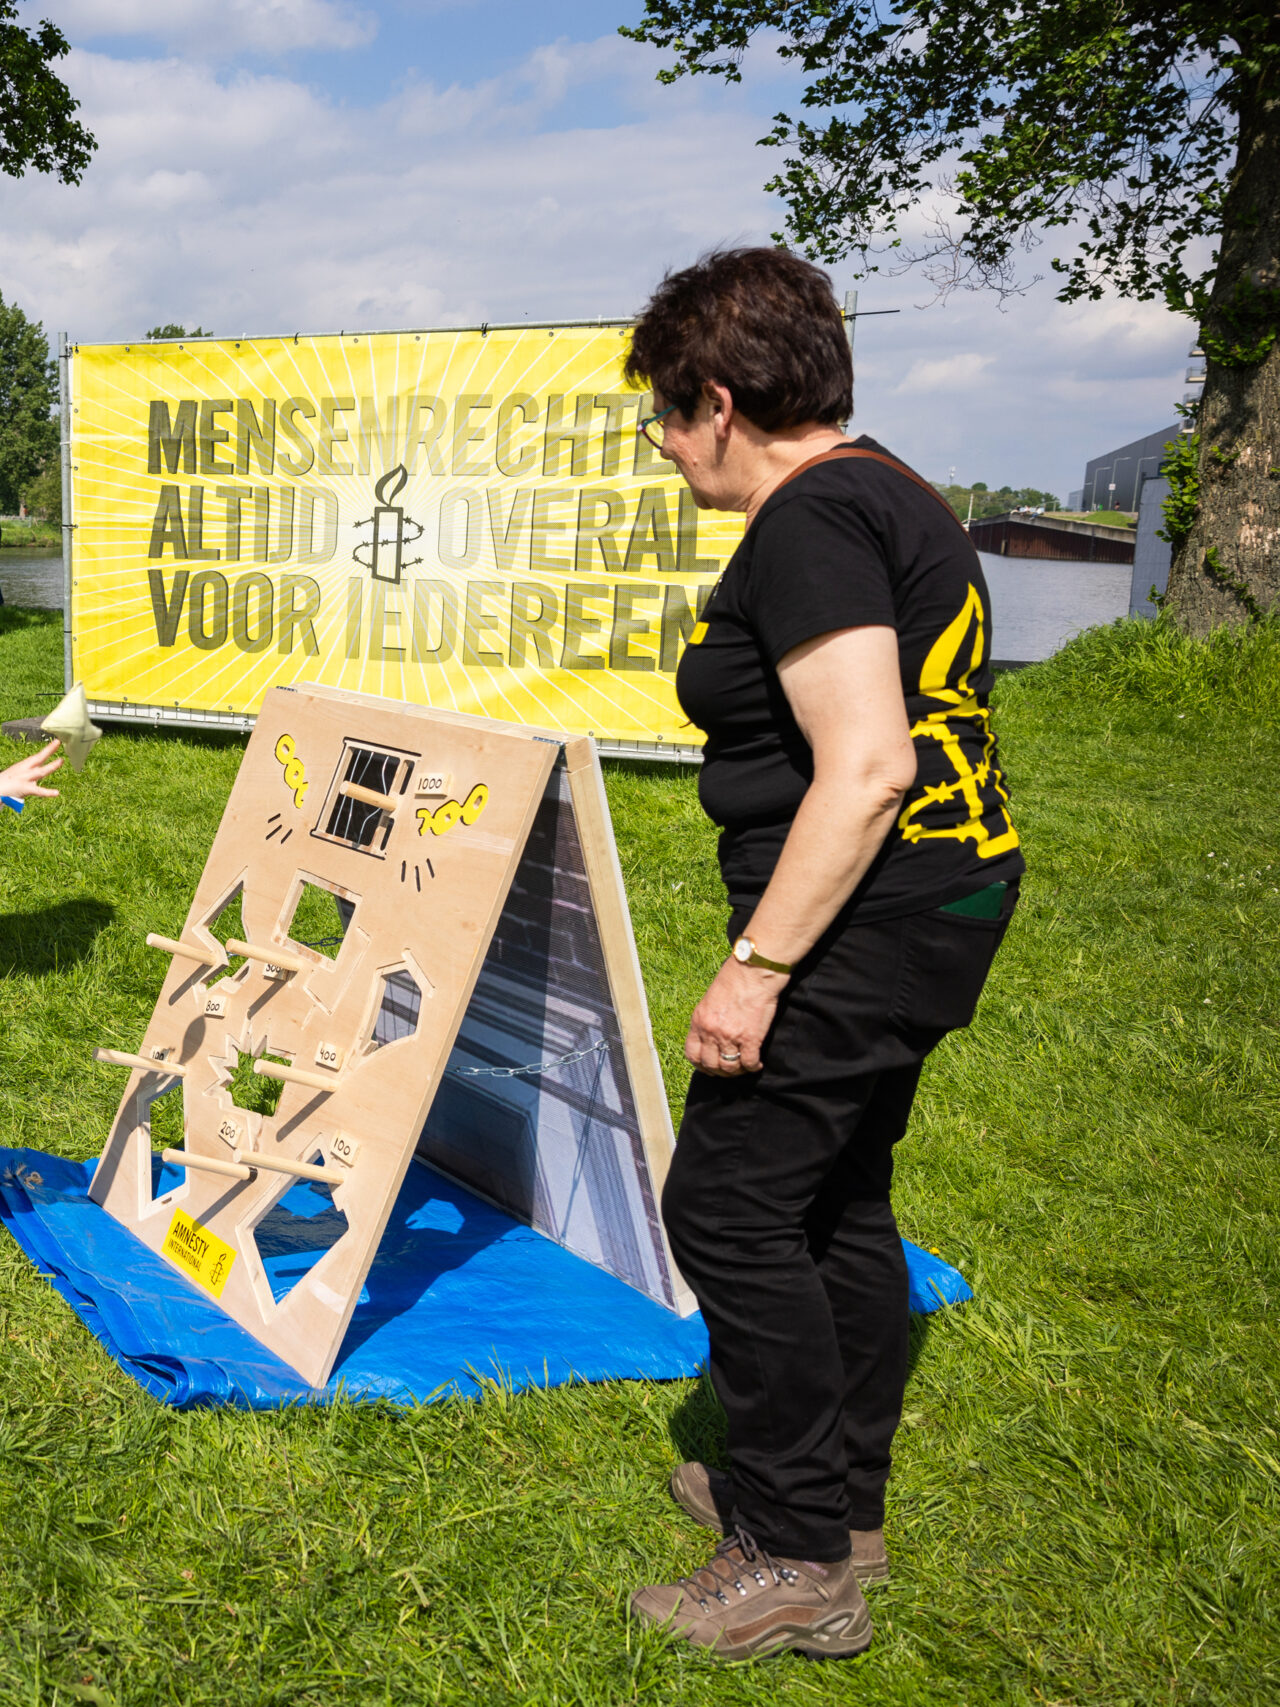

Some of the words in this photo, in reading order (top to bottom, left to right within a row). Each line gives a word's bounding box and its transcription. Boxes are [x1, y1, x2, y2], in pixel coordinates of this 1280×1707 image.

[147, 392, 683, 477] MENSENRECHTE
[148, 484, 339, 565] ALTIJD
[437, 486, 720, 573] OVERAL
[147, 569, 321, 657] VOOR
[344, 576, 715, 673] IEDEREEN
[417, 777, 443, 791] 1000
[205, 1000, 220, 1012] 800
[319, 1048, 337, 1062] 400
[220, 1121, 236, 1139] 200
[333, 1137, 351, 1156] 100
[172, 1220, 210, 1259] AMNESTY
[167, 1237, 202, 1273] INTERNATIONAL
